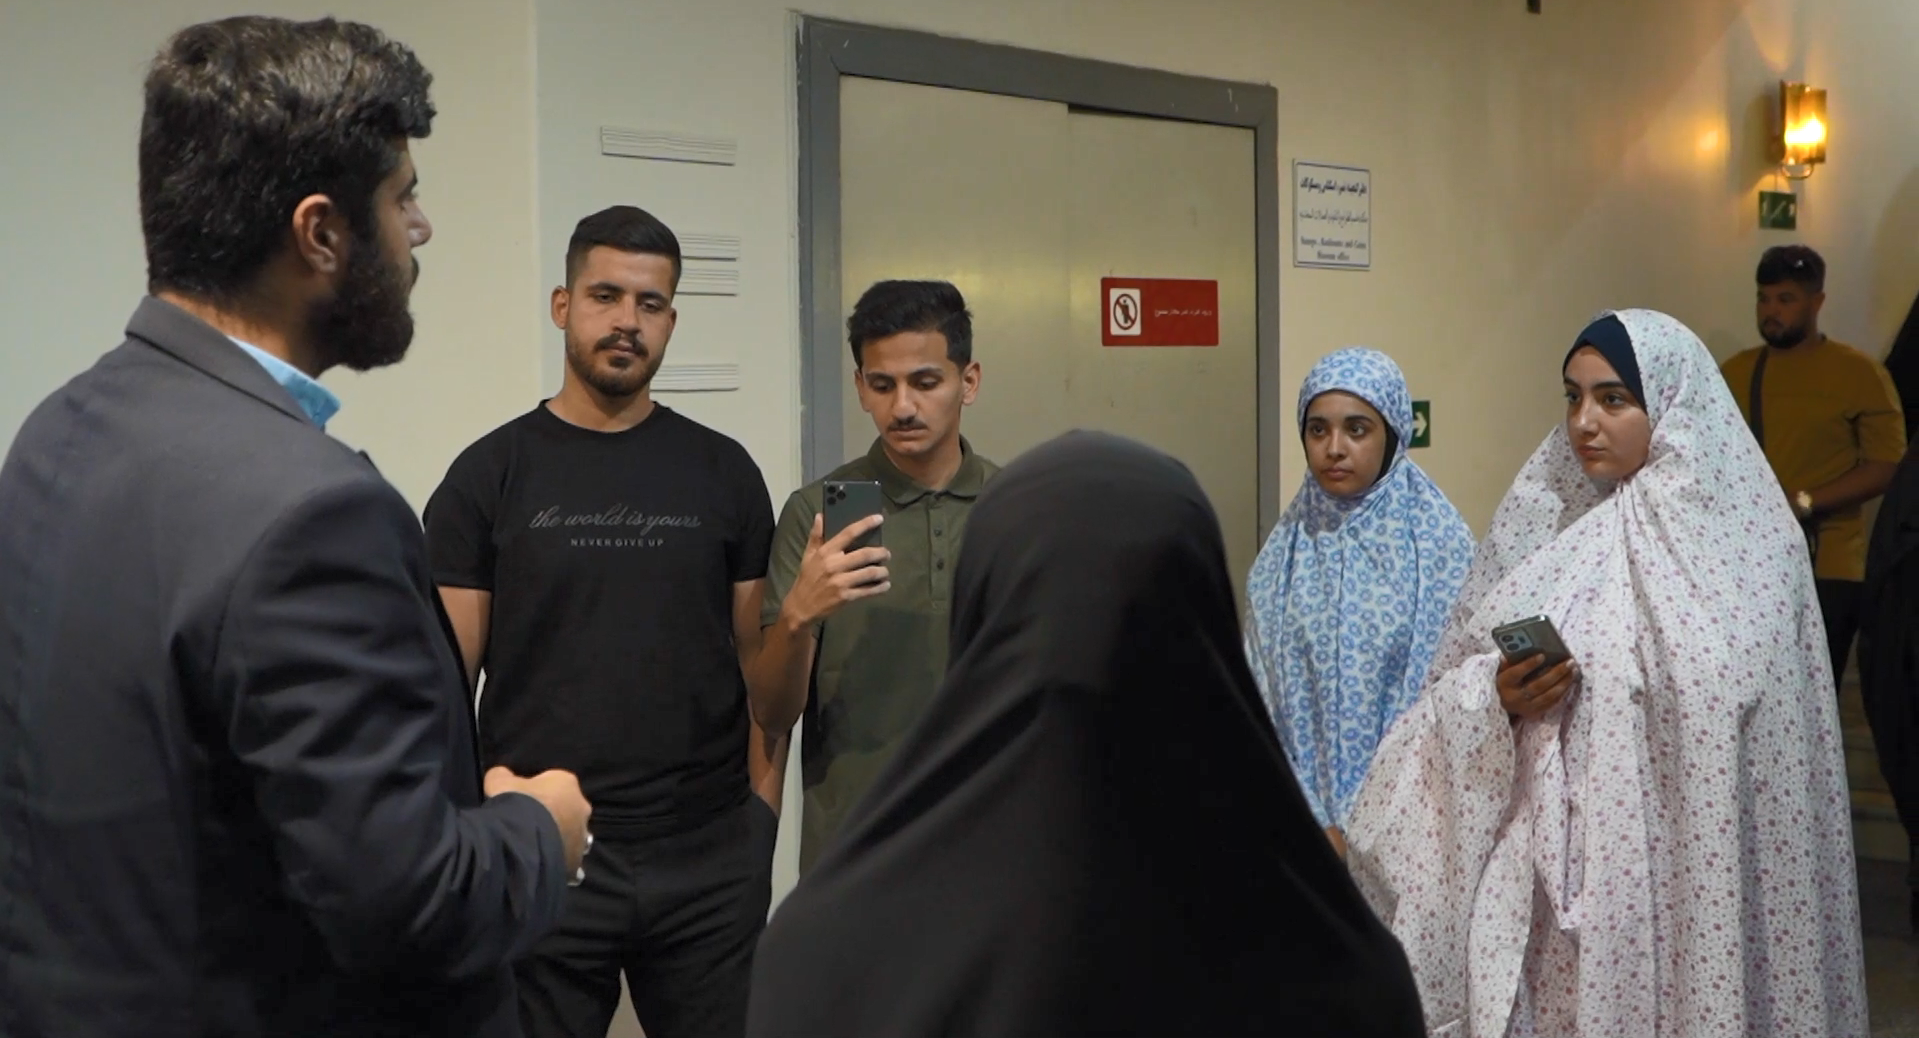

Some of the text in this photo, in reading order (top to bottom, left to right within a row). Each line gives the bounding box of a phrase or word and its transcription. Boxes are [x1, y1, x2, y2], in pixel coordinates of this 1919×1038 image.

[528, 502, 702, 537] the world is yours
[570, 537, 664, 548] NEVER GIVE UP
